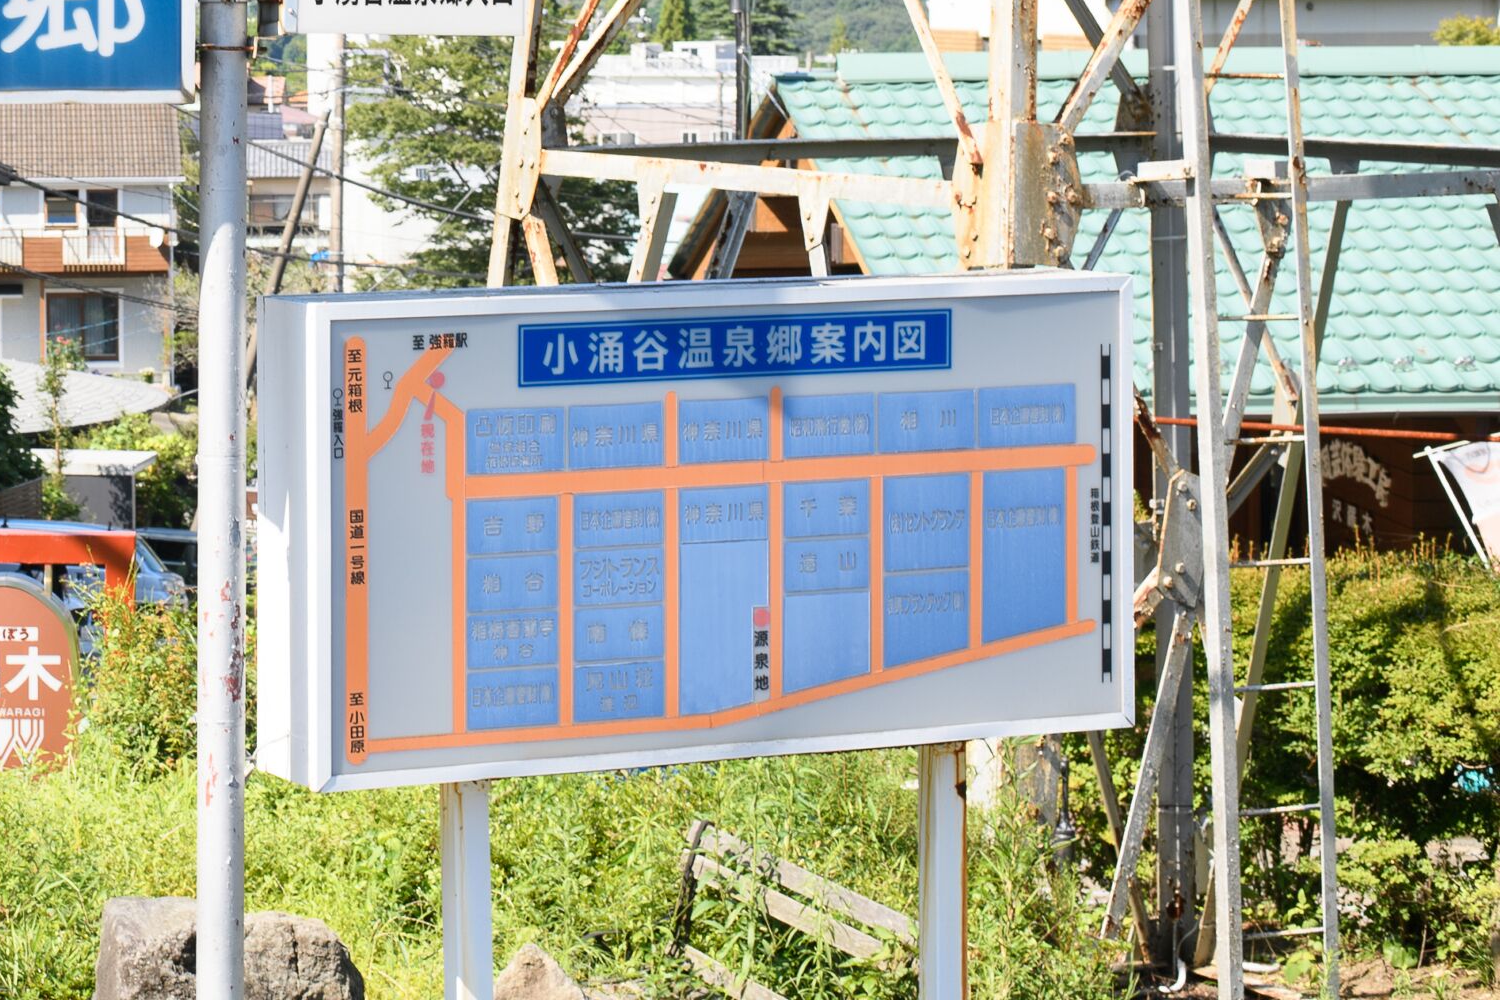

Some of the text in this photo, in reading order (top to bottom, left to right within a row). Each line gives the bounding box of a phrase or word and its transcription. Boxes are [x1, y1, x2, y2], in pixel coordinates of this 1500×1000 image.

[429, 332, 468, 350] 強羅駅
[542, 320, 927, 375] 小涌谷温泉郷案内図
[347, 368, 362, 413] 元箱根
[332, 408, 344, 459] 強羅入口
[421, 423, 435, 473] 現在地
[572, 424, 658, 447] 神奈川県
[683, 418, 763, 441] 神奈川県
[685, 501, 764, 524] 神奈川県
[349, 509, 365, 584] 国道一号線
[754, 630, 769, 691] 源泉地
[349, 711, 365, 753] 小田原
